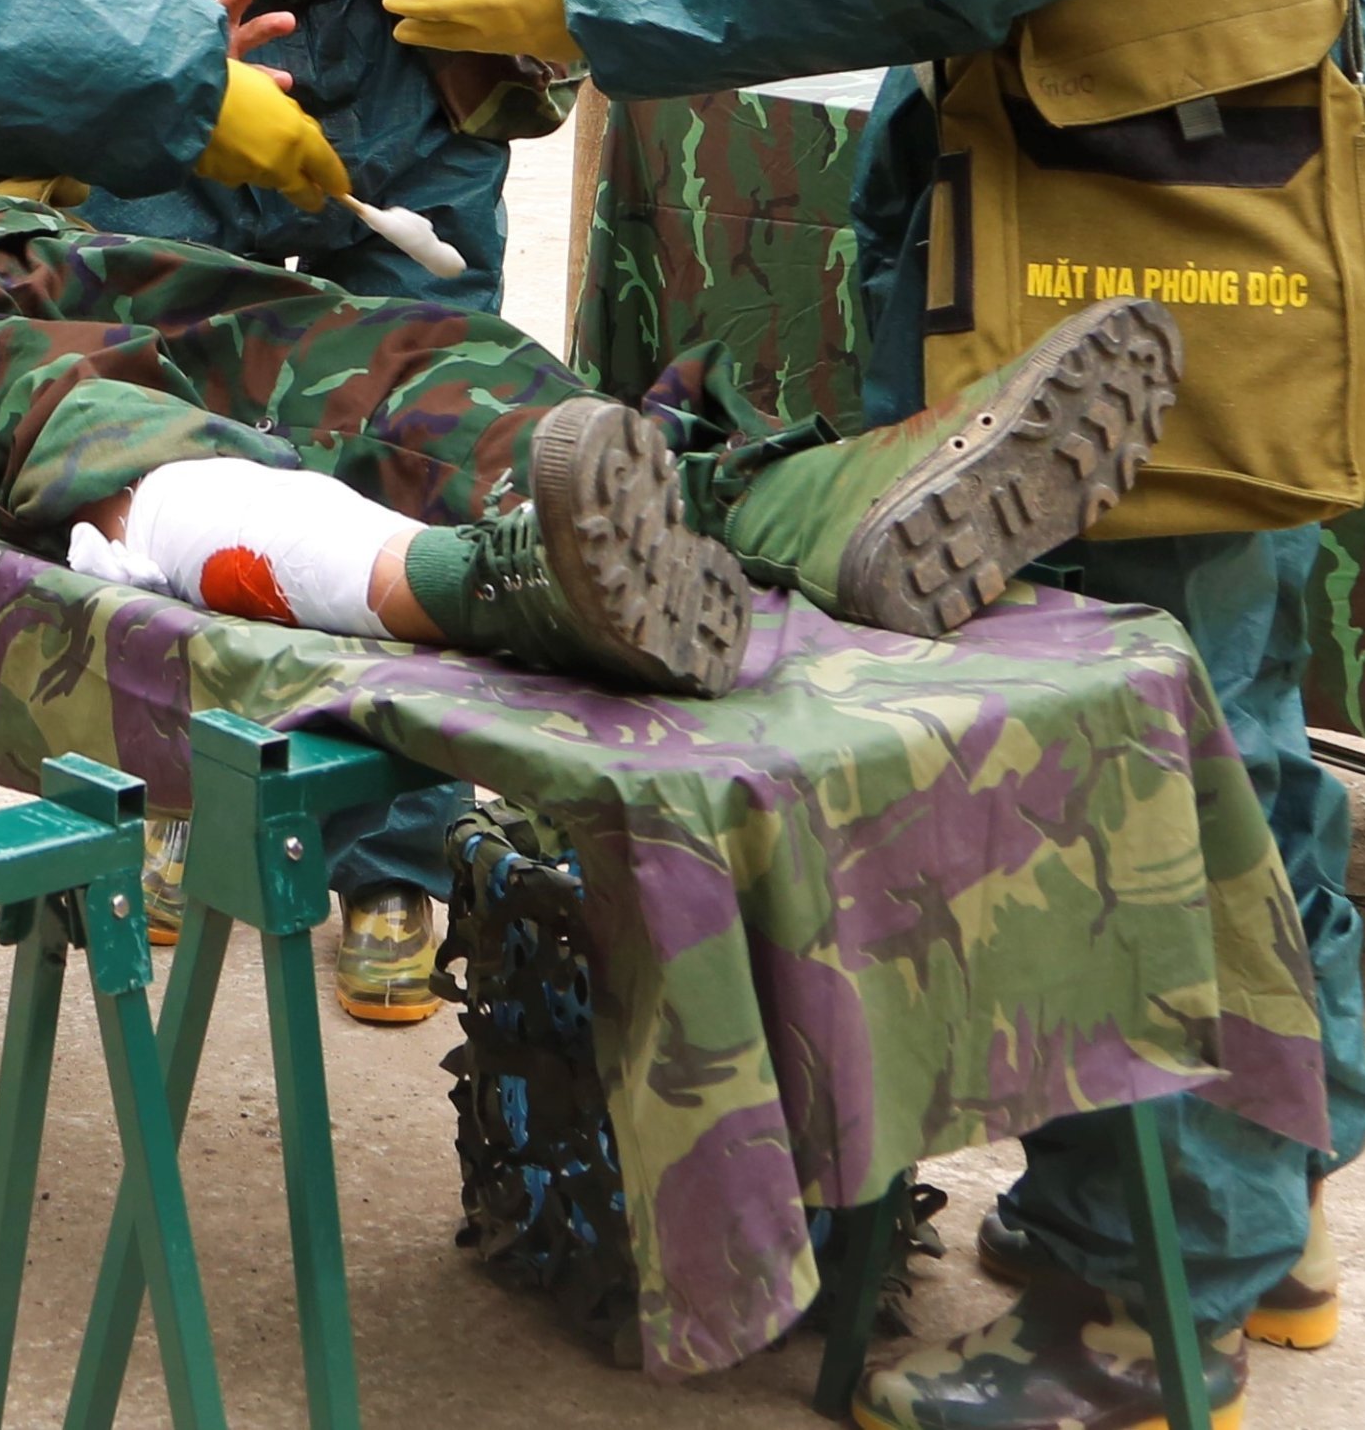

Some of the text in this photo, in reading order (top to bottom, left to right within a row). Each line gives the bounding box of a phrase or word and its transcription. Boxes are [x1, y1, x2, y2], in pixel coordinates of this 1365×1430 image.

[1027, 258, 1308, 315] MẶT NA PHÒNG ĐỘC
